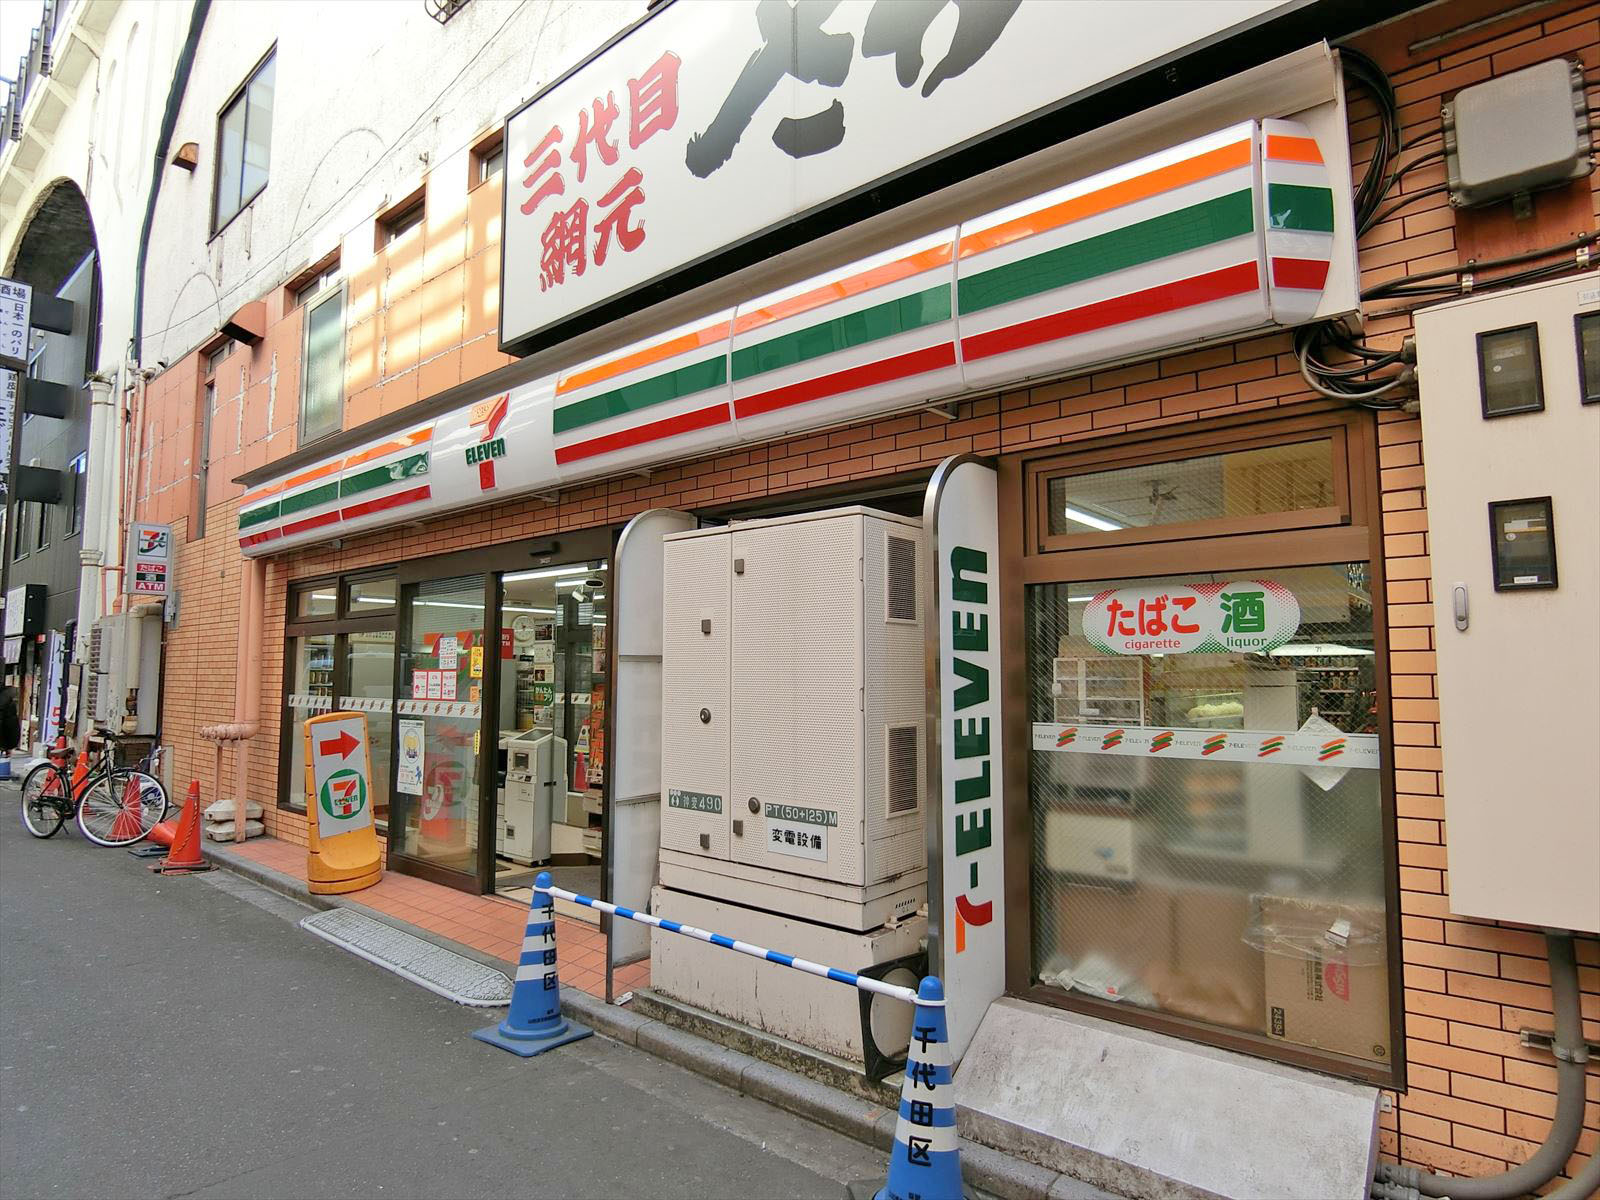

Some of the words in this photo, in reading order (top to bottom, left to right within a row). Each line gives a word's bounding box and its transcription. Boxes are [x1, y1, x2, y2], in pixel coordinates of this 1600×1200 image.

[520, 50, 681, 215] 三代目
[540, 167, 646, 292] 網元
[137, 583, 164, 591] ATM
[1106, 594, 1200, 637] たばこ
[1220, 591, 1265, 633] 酒
[1124, 638, 1181, 651] cigarette
[1226, 637, 1268, 651] liquor
[765, 804, 838, 826] PT(50+125)M
[772, 828, 822, 850] 変電設備
[908, 1026, 938, 1167] 千代田区
